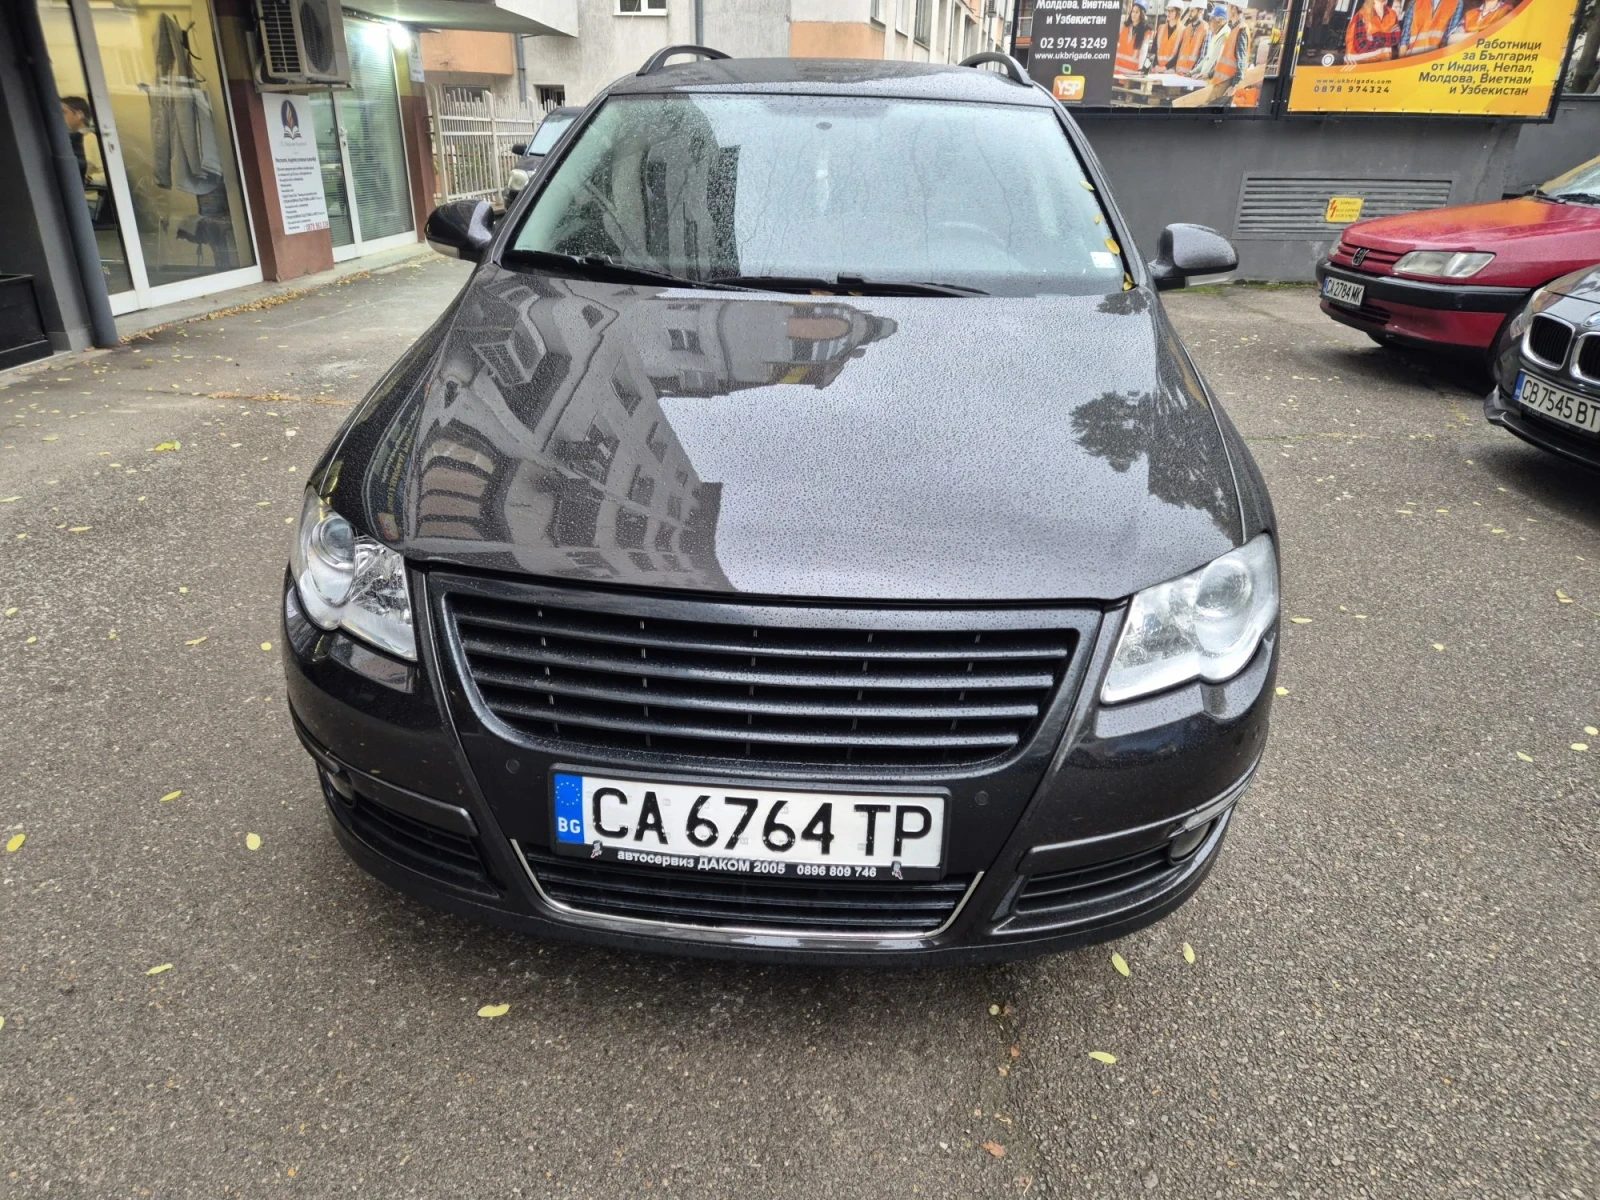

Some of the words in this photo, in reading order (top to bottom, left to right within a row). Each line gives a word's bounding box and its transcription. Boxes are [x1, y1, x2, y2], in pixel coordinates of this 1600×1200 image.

[1081, 0, 1120, 9] Виетнам
[1046, 15, 1053, 25] и
[1055, 13, 1107, 25] Узбекистан
[1040, 37, 1054, 49] 02
[1057, 37, 1078, 49] 974
[1080, 37, 1108, 49] 3249
[1475, 38, 1541, 50] Работници
[1034, 52, 1110, 61] www.ukbrigade.com
[1462, 52, 1476, 61] за
[1479, 50, 1538, 62] България
[1431, 63, 1444, 72] от
[1448, 61, 1489, 74] Индия,
[1494, 62, 1534, 74] Непал,
[1419, 72, 1475, 85] Молдова,
[1480, 74, 1532, 85] Виетнам
[1056, 79, 1082, 96] YSP
[1314, 85, 1342, 93] 0878
[1348, 85, 1390, 93] 974324
[1449, 86, 1457, 95] и
[1460, 84, 1528, 97] Узбекистан
[1334, 281, 1352, 301] 2784
[1522, 379, 1539, 404] CB
[1538, 387, 1574, 420] 7545
[1575, 400, 1600, 429] BT
[557, 816, 581, 835] BG
[592, 786, 668, 845] CA
[685, 794, 835, 856] 6764
[854, 803, 932, 858] TP
[617, 849, 695, 869] автосервиз
[697, 856, 750, 874] ДАКОМ
[753, 861, 786, 875] 2005
[796, 863, 826, 877] 0896
[829, 864, 850, 878] 809
[854, 865, 877, 879] 746
